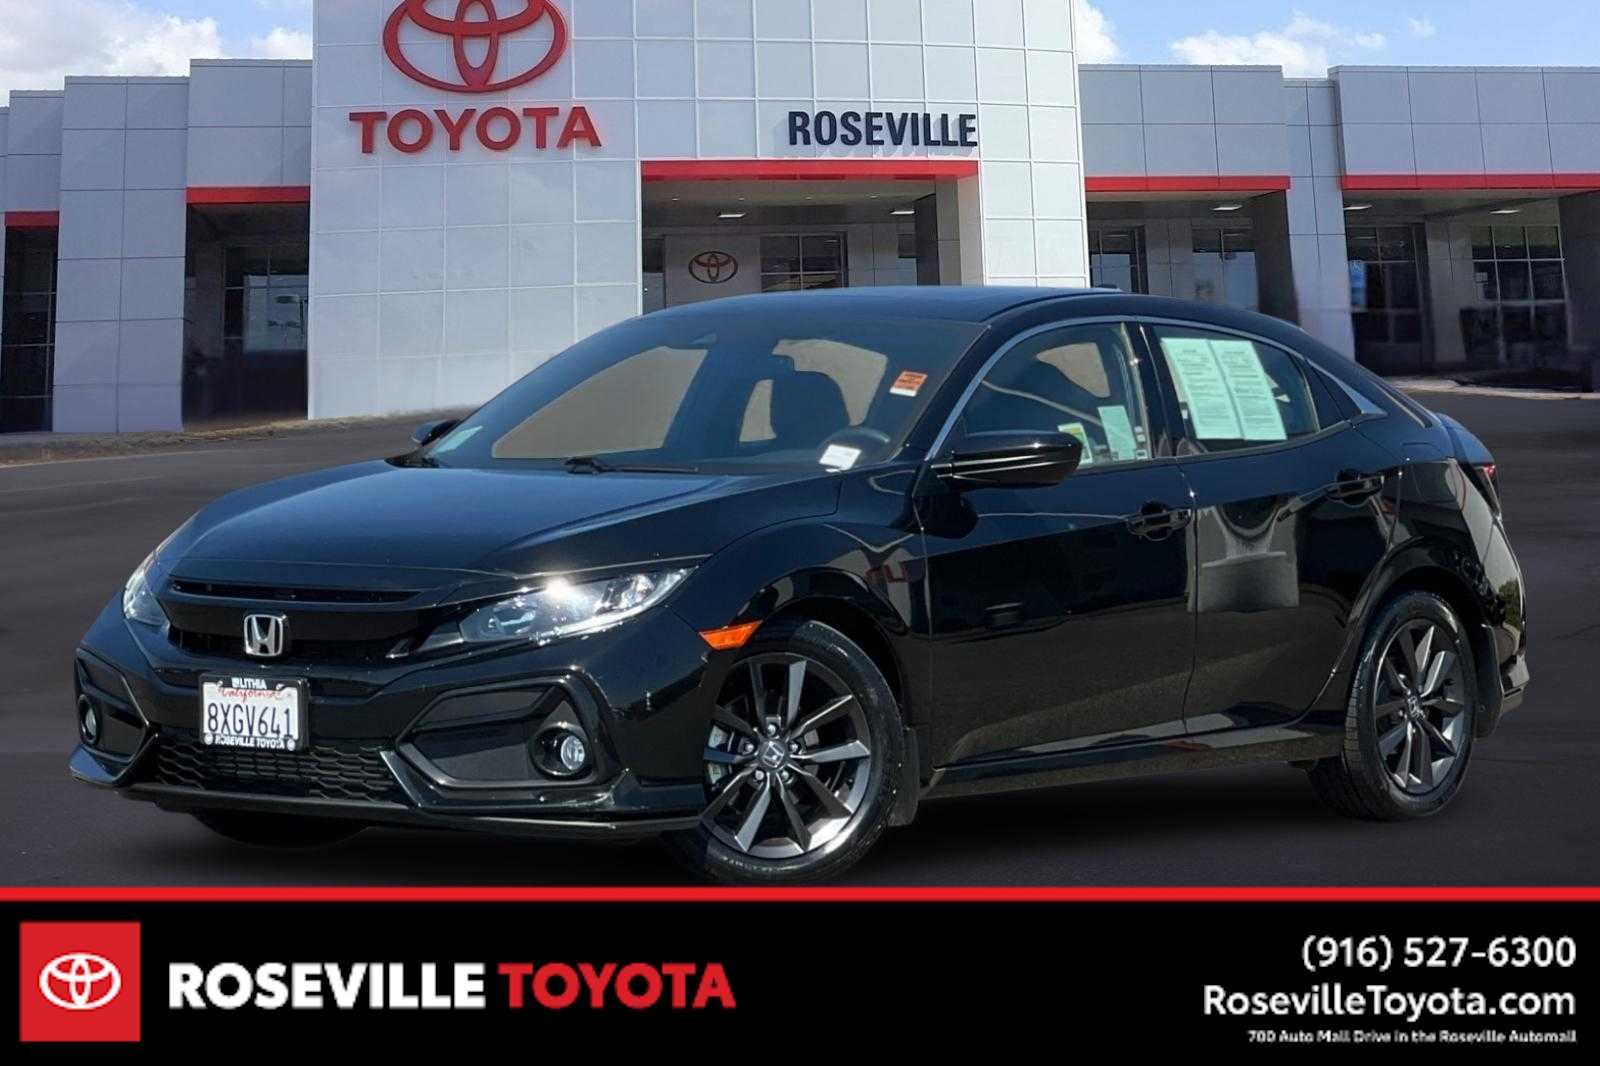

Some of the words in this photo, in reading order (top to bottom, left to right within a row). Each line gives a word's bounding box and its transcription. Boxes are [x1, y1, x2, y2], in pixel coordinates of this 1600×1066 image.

[350, 106, 602, 154] TOYOTA
[789, 111, 978, 147] ROSEVILLE
[207, 702, 293, 737] 8XGV641
[215, 734, 255, 747] ROSEVILLE
[256, 738, 285, 749] TOYOTA
